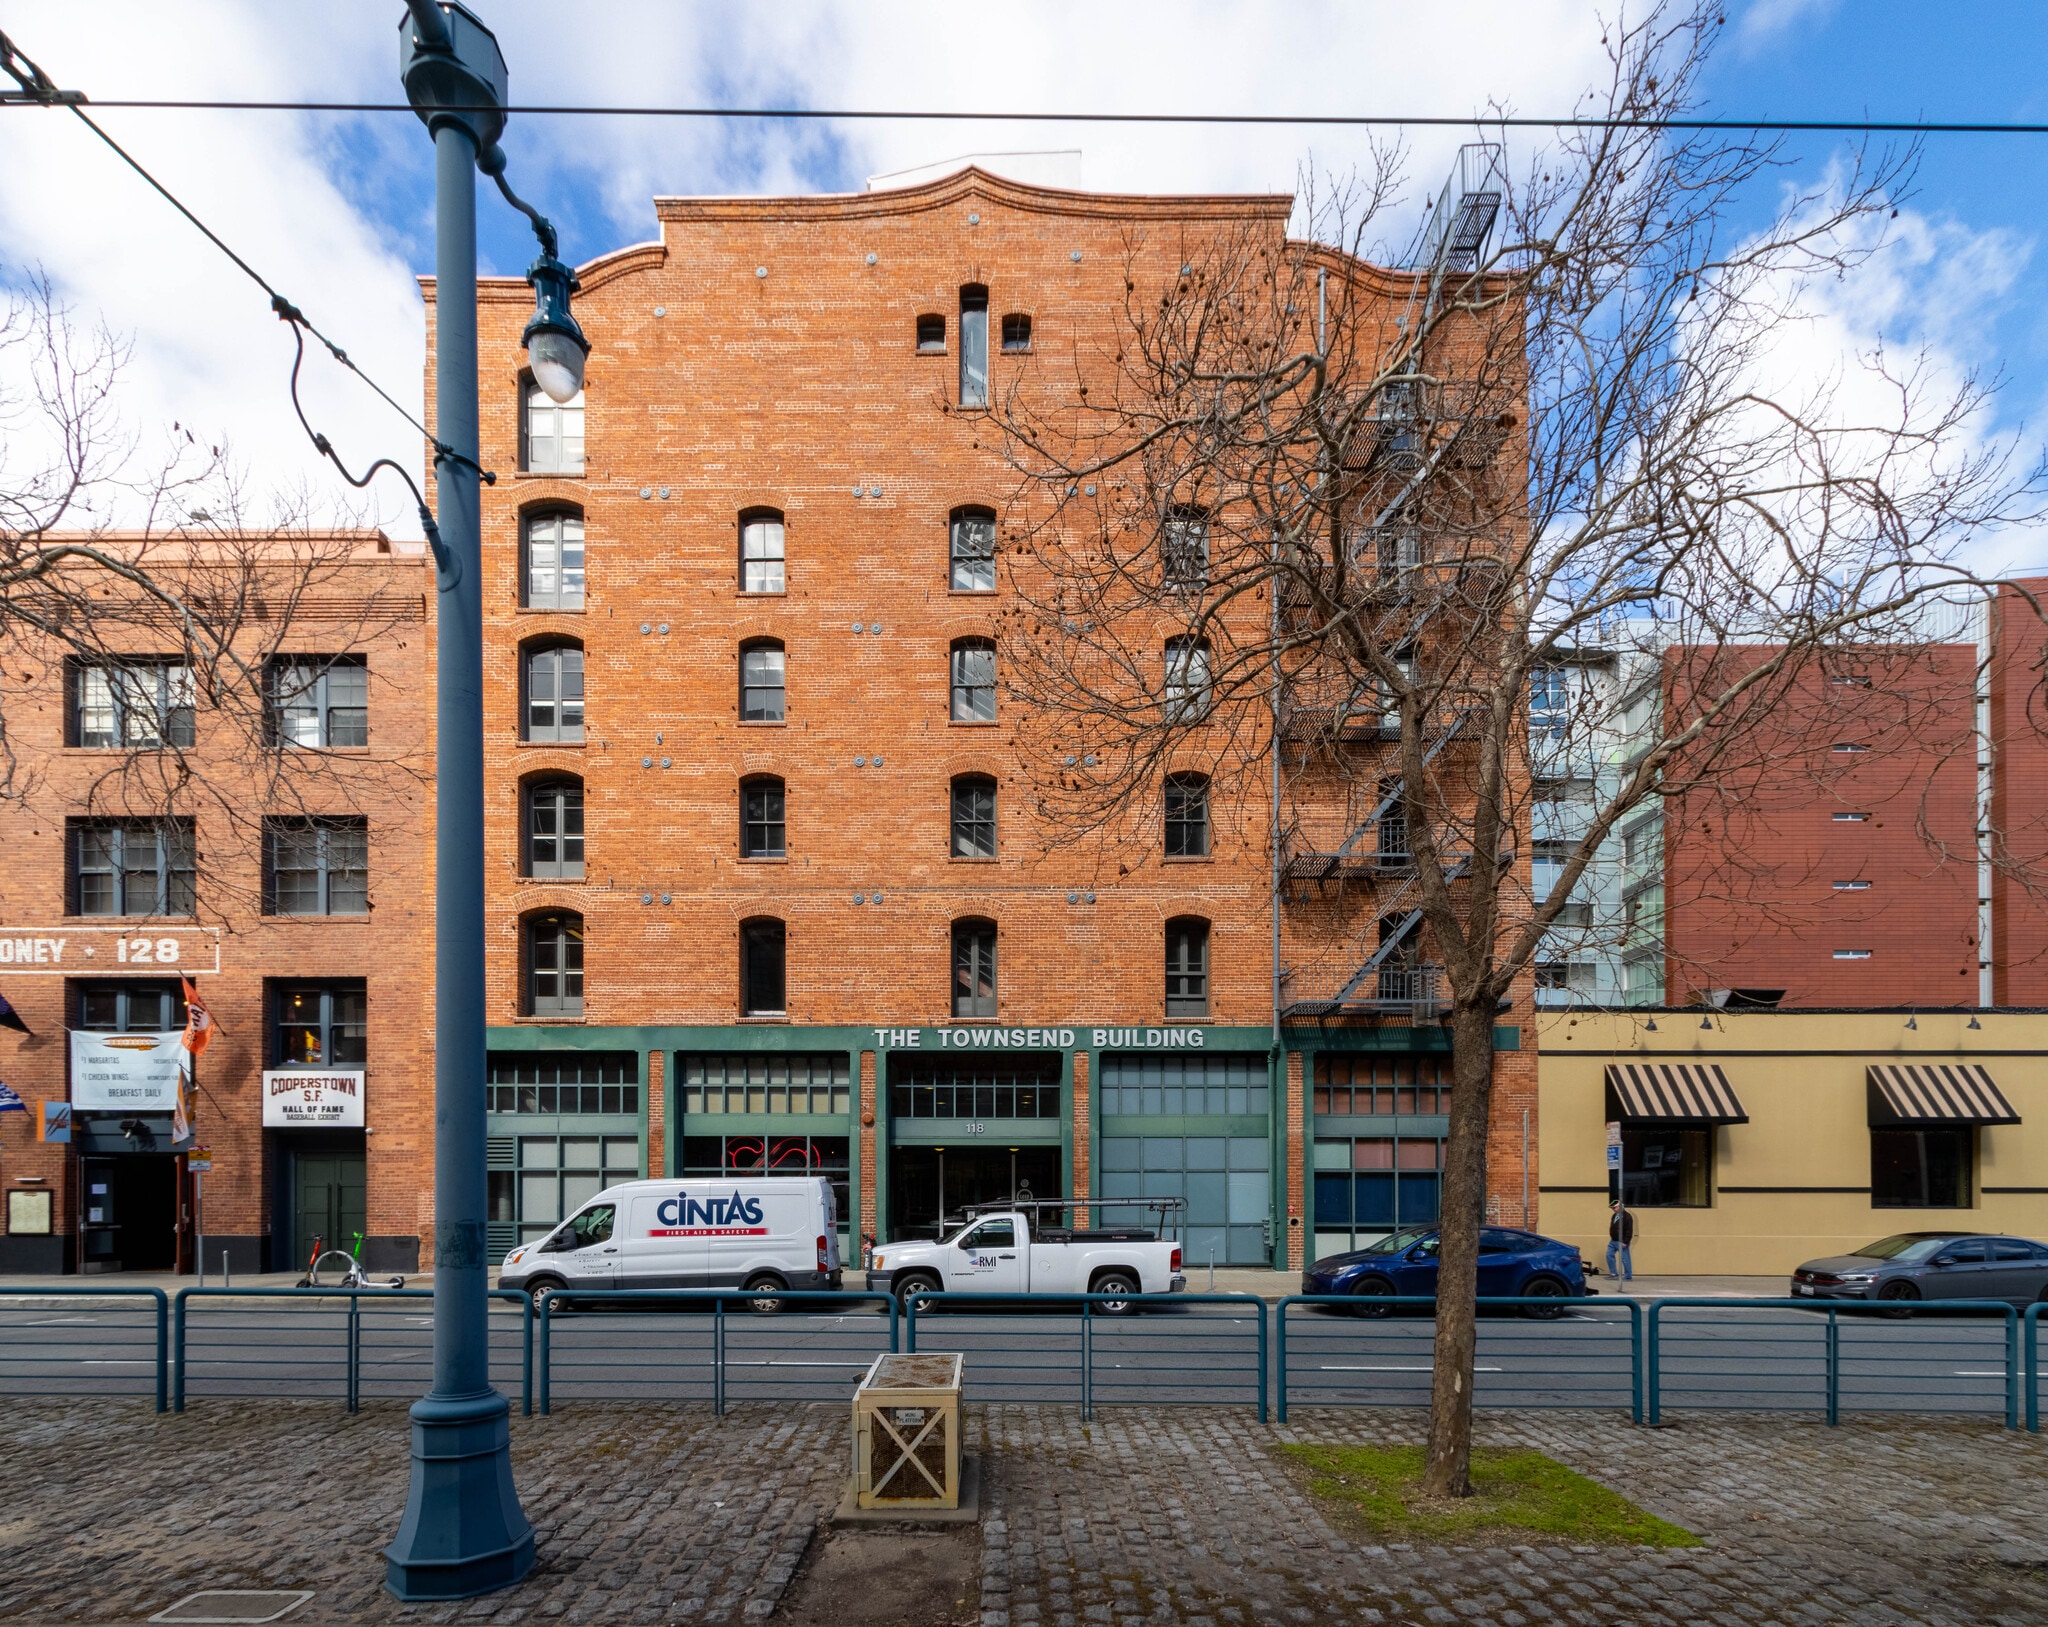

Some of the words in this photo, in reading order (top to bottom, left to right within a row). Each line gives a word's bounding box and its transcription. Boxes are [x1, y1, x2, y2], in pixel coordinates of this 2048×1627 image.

[116, 938, 180, 963] 128
[874, 1029, 921, 1047] THE
[938, 1029, 1076, 1047] TOWNSEND
[1093, 1029, 1204, 1047] BUILDING
[88, 1056, 120, 1065] MARGARITAS
[88, 1073, 110, 1081] CHICKEN
[112, 1073, 129, 1081] WINGS
[271, 1078, 356, 1096] COOPERSTOWN
[108, 1088, 142, 1098] BREAKFAST
[144, 1088, 162, 1097] DAILY
[303, 1090, 323, 1102] S.F.
[282, 1105, 304, 1113] HALL
[307, 1105, 318, 1113] OF
[321, 1105, 344, 1113] FAME
[286, 1113, 316, 1121] BASEBALL
[317, 1113, 341, 1121] EXHIBIT
[965, 1122, 985, 1135] 118
[657, 1189, 764, 1227] CINTAS
[979, 1256, 997, 1267] RMI
